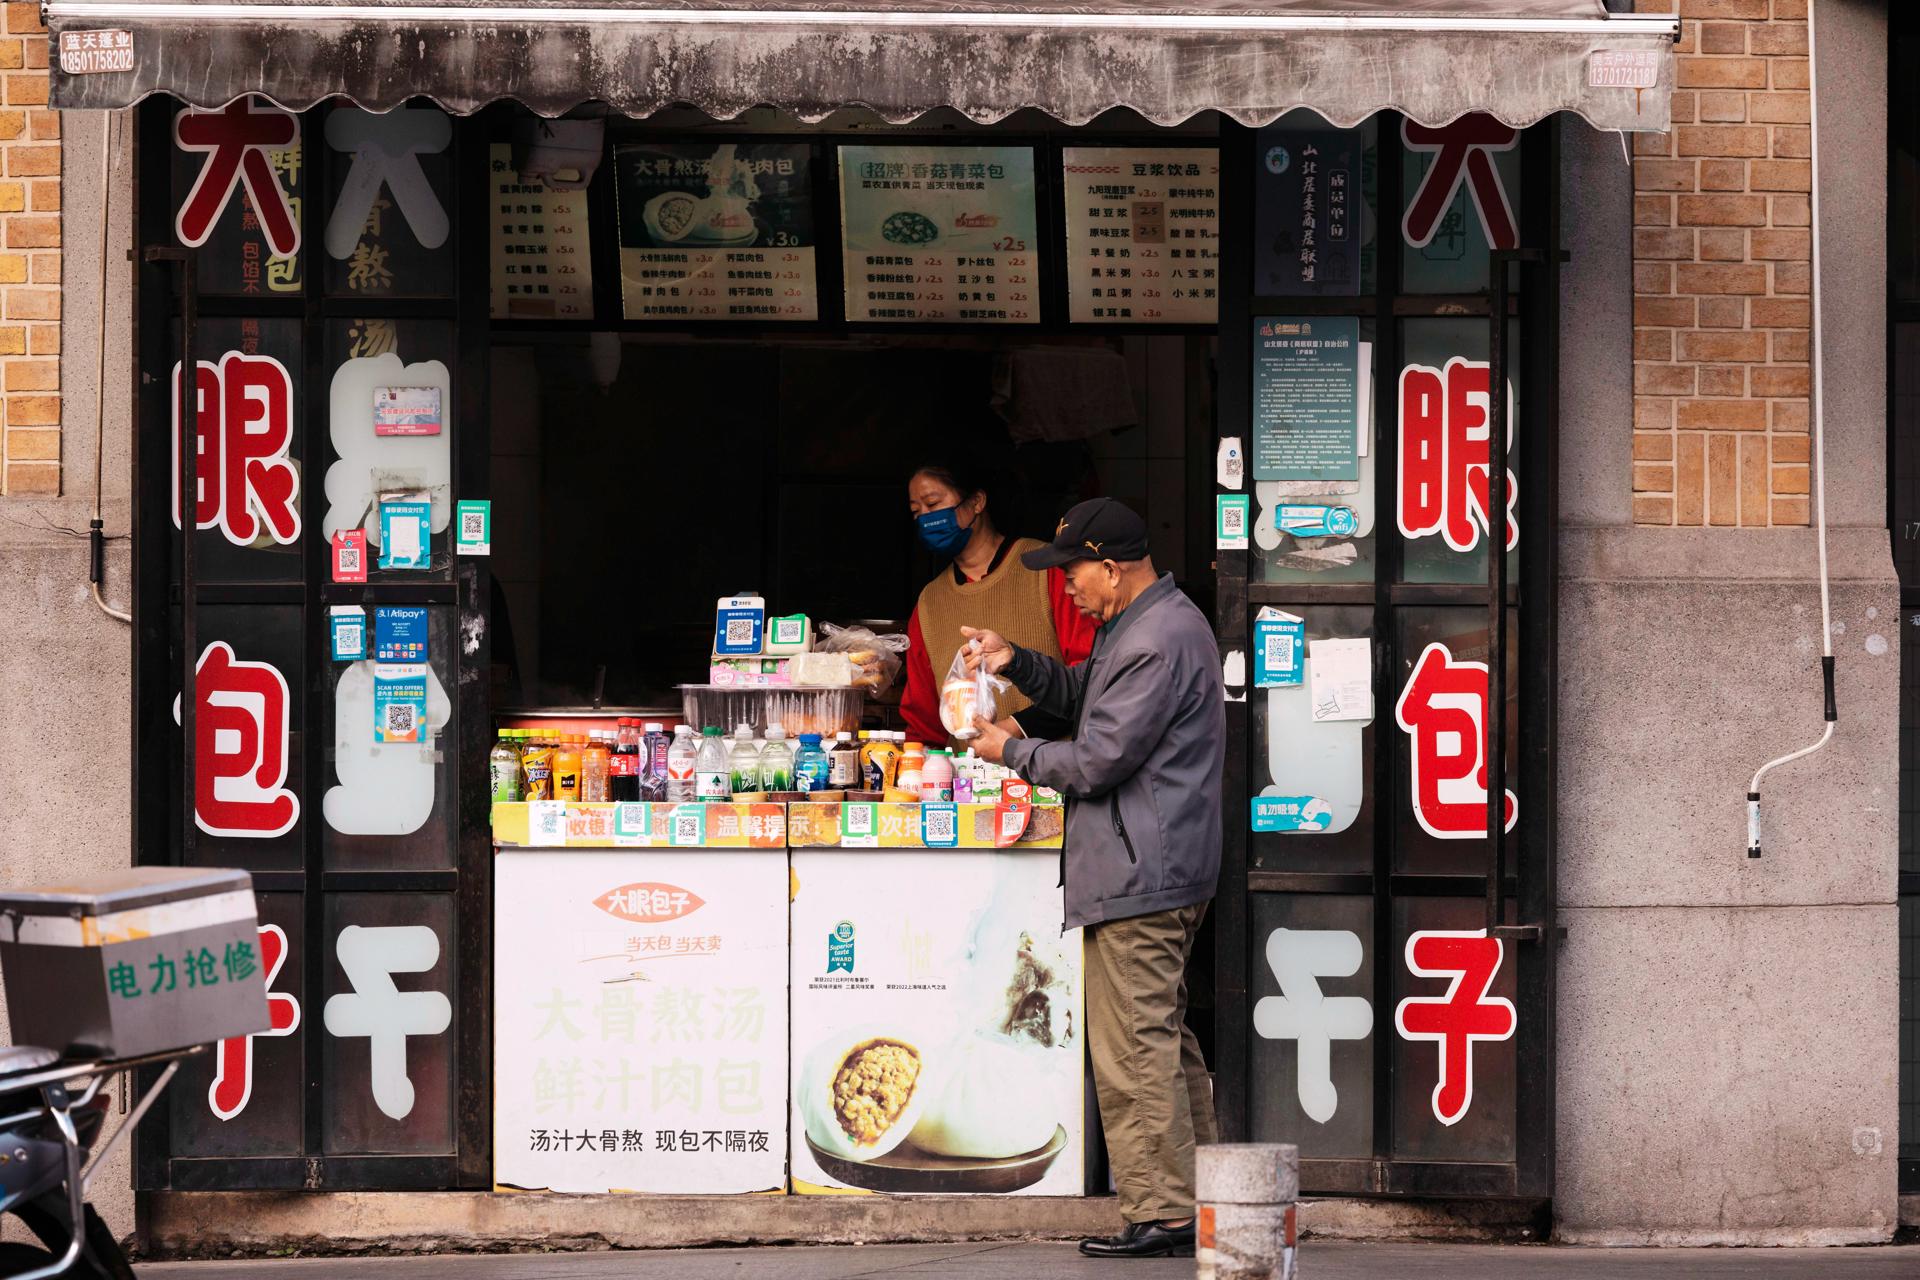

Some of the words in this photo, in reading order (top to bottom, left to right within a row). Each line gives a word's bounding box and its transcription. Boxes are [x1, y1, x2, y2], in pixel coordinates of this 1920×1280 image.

[62, 49, 132, 71] 18501758202
[911, 163, 1004, 179] 香菇青菜包
[1132, 164, 1201, 177] 豆浆饮品
[993, 237, 1025, 251] ¥2.5
[608, 889, 690, 916] 大眼包子
[626, 935, 672, 953] 当天包
[674, 934, 722, 953] 当天卖
[108, 940, 258, 999] 电力抢修
[531, 986, 768, 1044] 大骨熬汤
[532, 1056, 768, 1115] 鲜汁肉包
[530, 1129, 643, 1153] 汤汁大骨熬
[655, 1129, 771, 1153] 现包不隔夜
